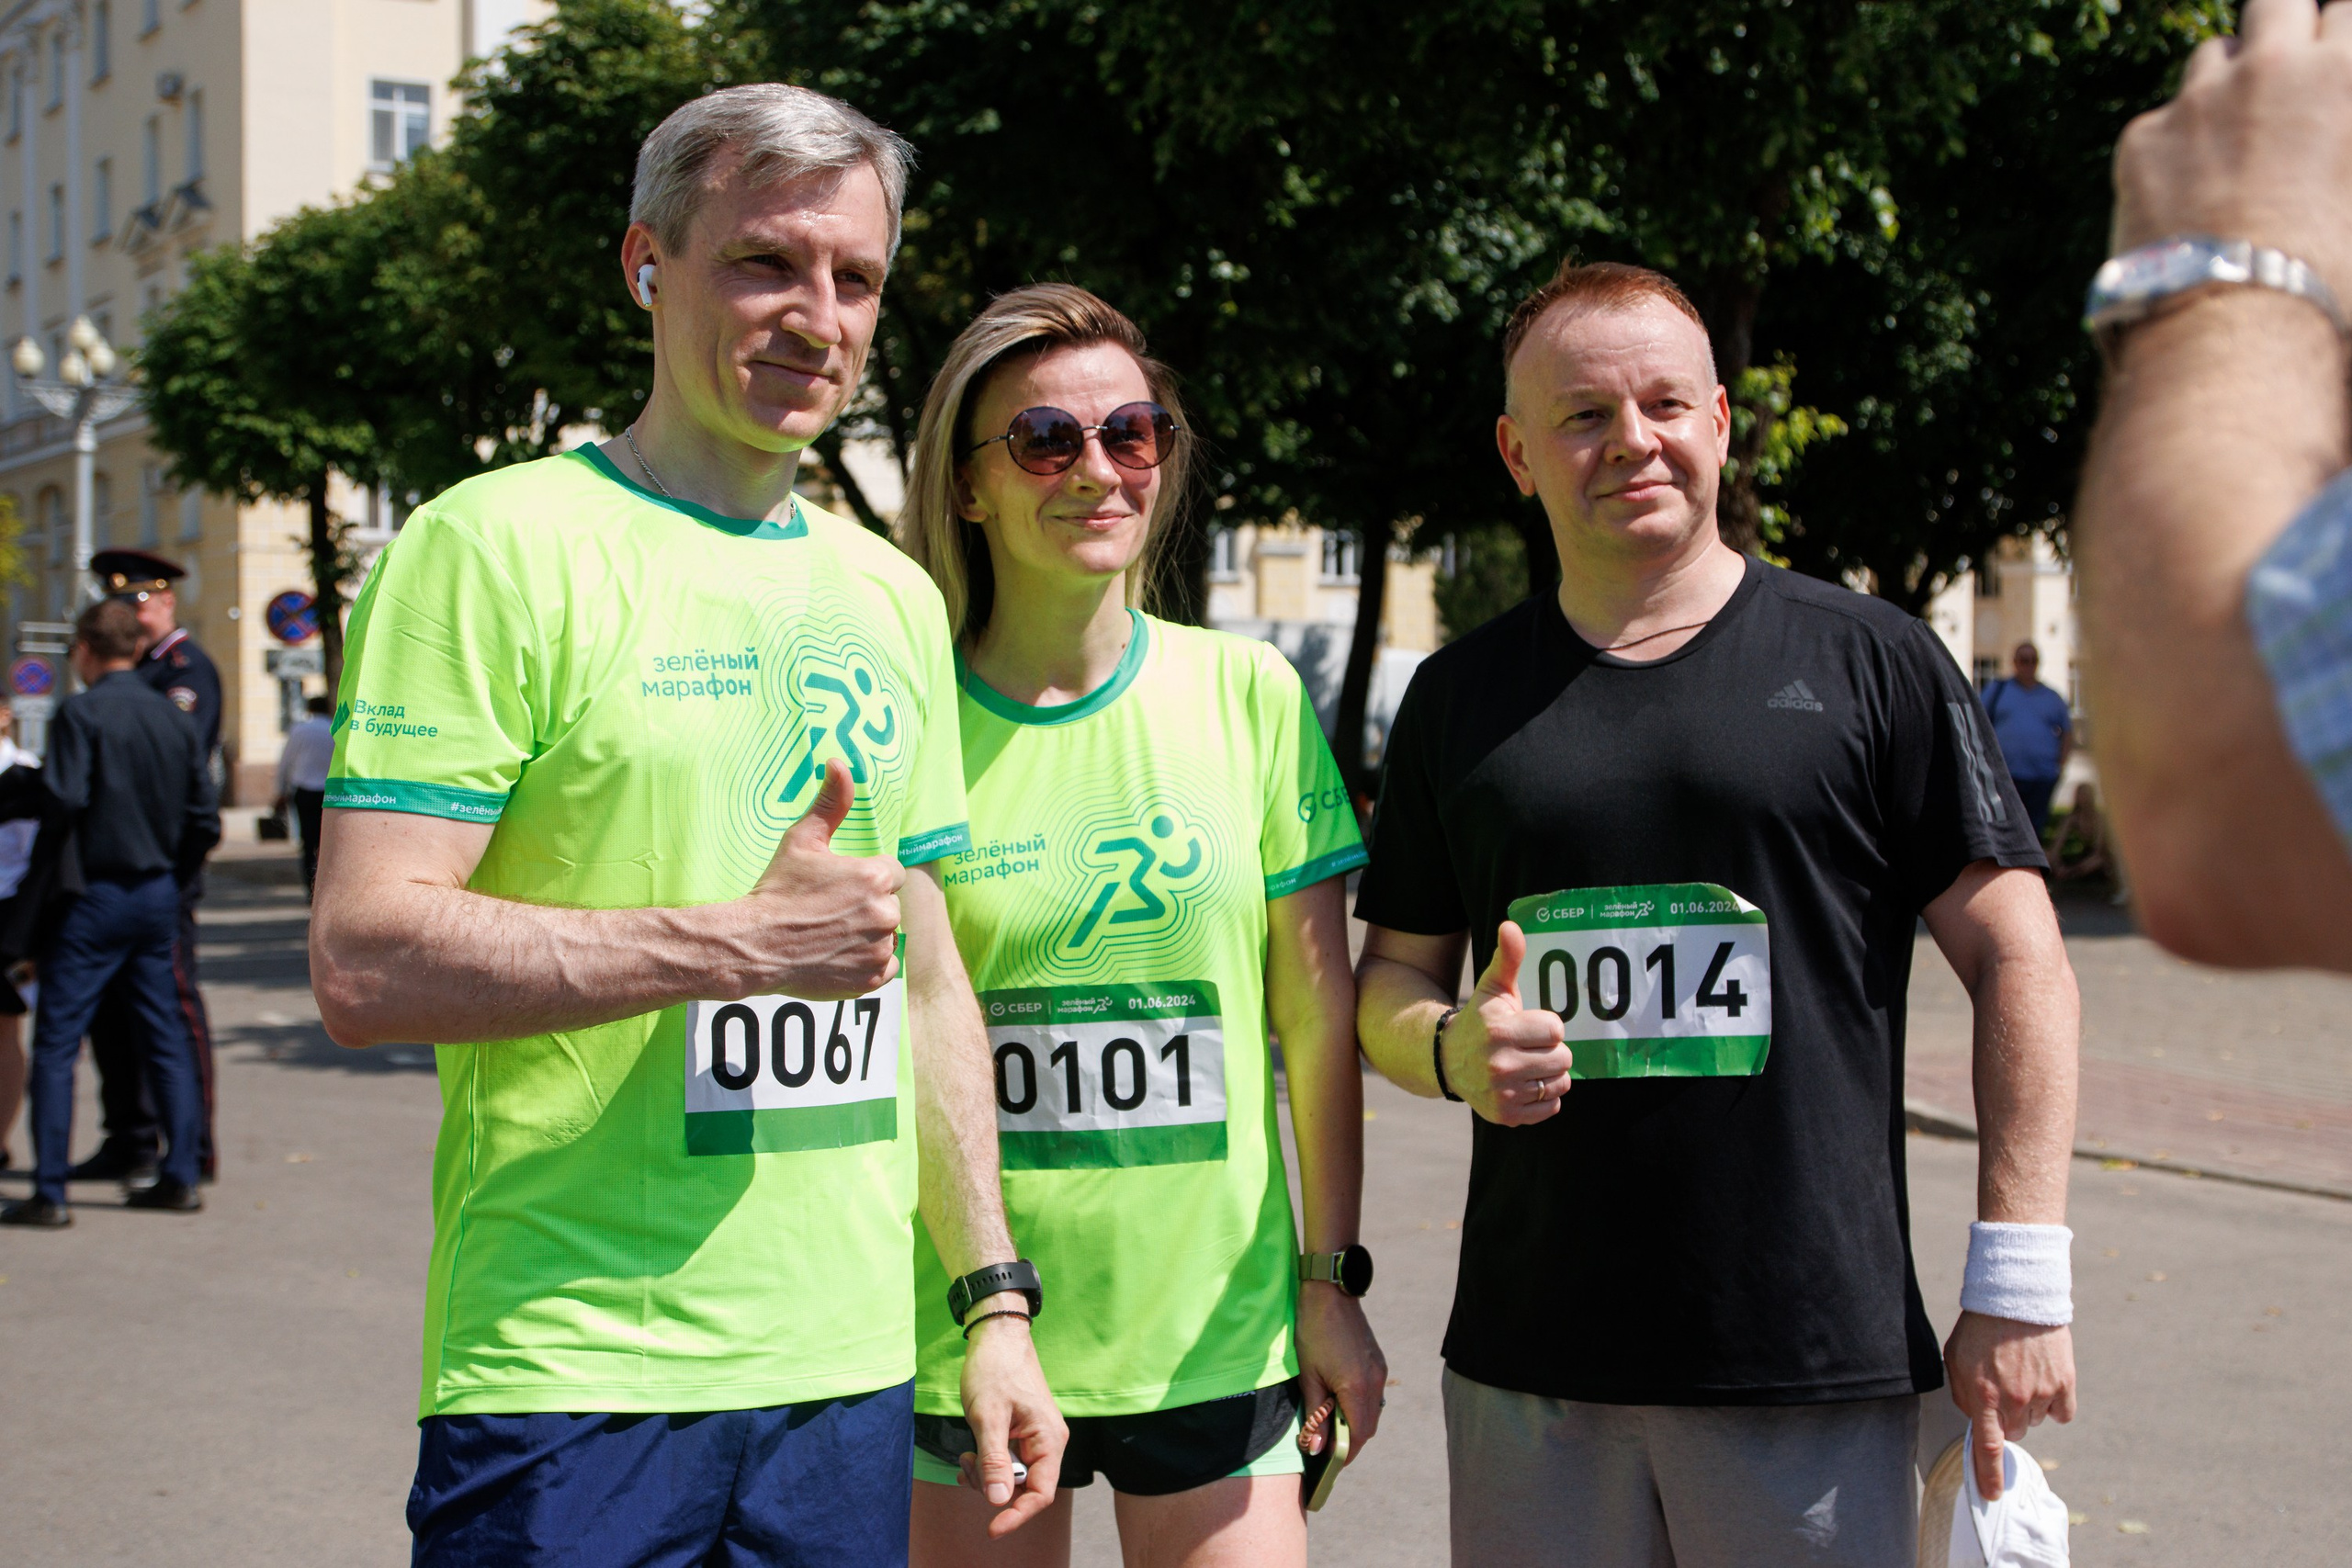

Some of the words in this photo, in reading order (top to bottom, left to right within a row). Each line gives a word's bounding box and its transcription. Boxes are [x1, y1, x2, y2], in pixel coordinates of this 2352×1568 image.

[653, 646, 759, 672] зелёный
[641, 672, 752, 702] марафон
[354, 699, 405, 718] Вклад
[1767, 694, 1824, 712] adidas
[350, 719, 360, 730] в
[365, 717, 438, 738] будущее
[954, 832, 1046, 865] зелёный
[944, 857, 1040, 887] марафон
[1553, 907, 1585, 919] СБЕР
[1600, 908, 1635, 919] марафон
[1604, 901, 1638, 910] зелёный
[1670, 901, 1739, 915] 01.06.2024
[1538, 941, 1748, 1024] 0014
[1008, 1002, 1043, 1014] СБЕР
[1057, 1005, 1093, 1014] марафон
[1061, 997, 1096, 1007] зелёный
[1128, 994, 1196, 1010] 01.06.2024
[711, 998, 881, 1091] 0067
[993, 1034, 1192, 1115] 0101
